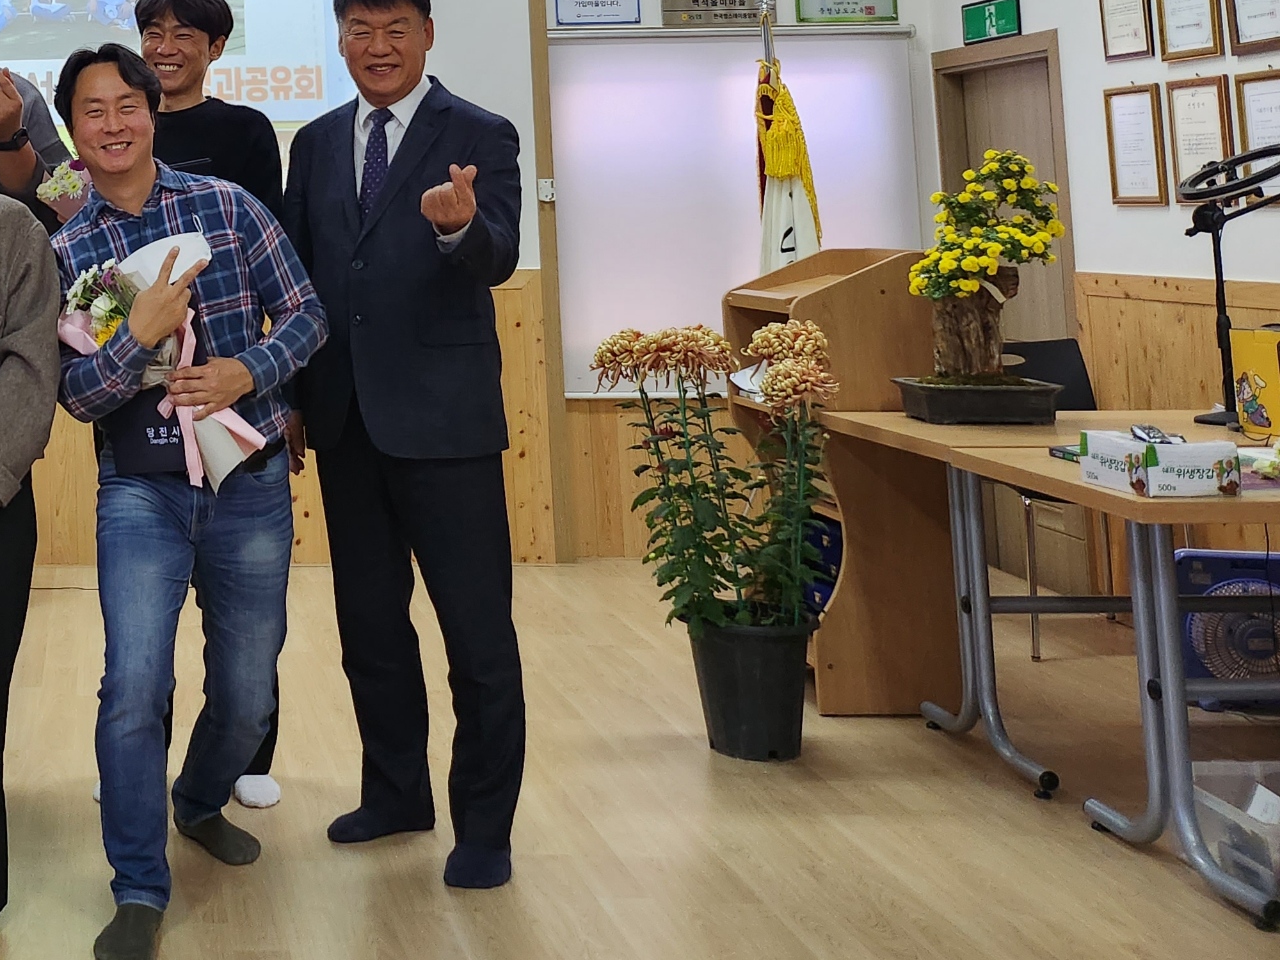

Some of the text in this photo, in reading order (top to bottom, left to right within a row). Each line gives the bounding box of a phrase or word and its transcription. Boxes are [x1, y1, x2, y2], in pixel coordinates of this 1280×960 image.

[204, 64, 324, 103] 과공유회
[1100, 455, 1126, 473] 위생장갑
[1176, 468, 1214, 480] 위생장갑
